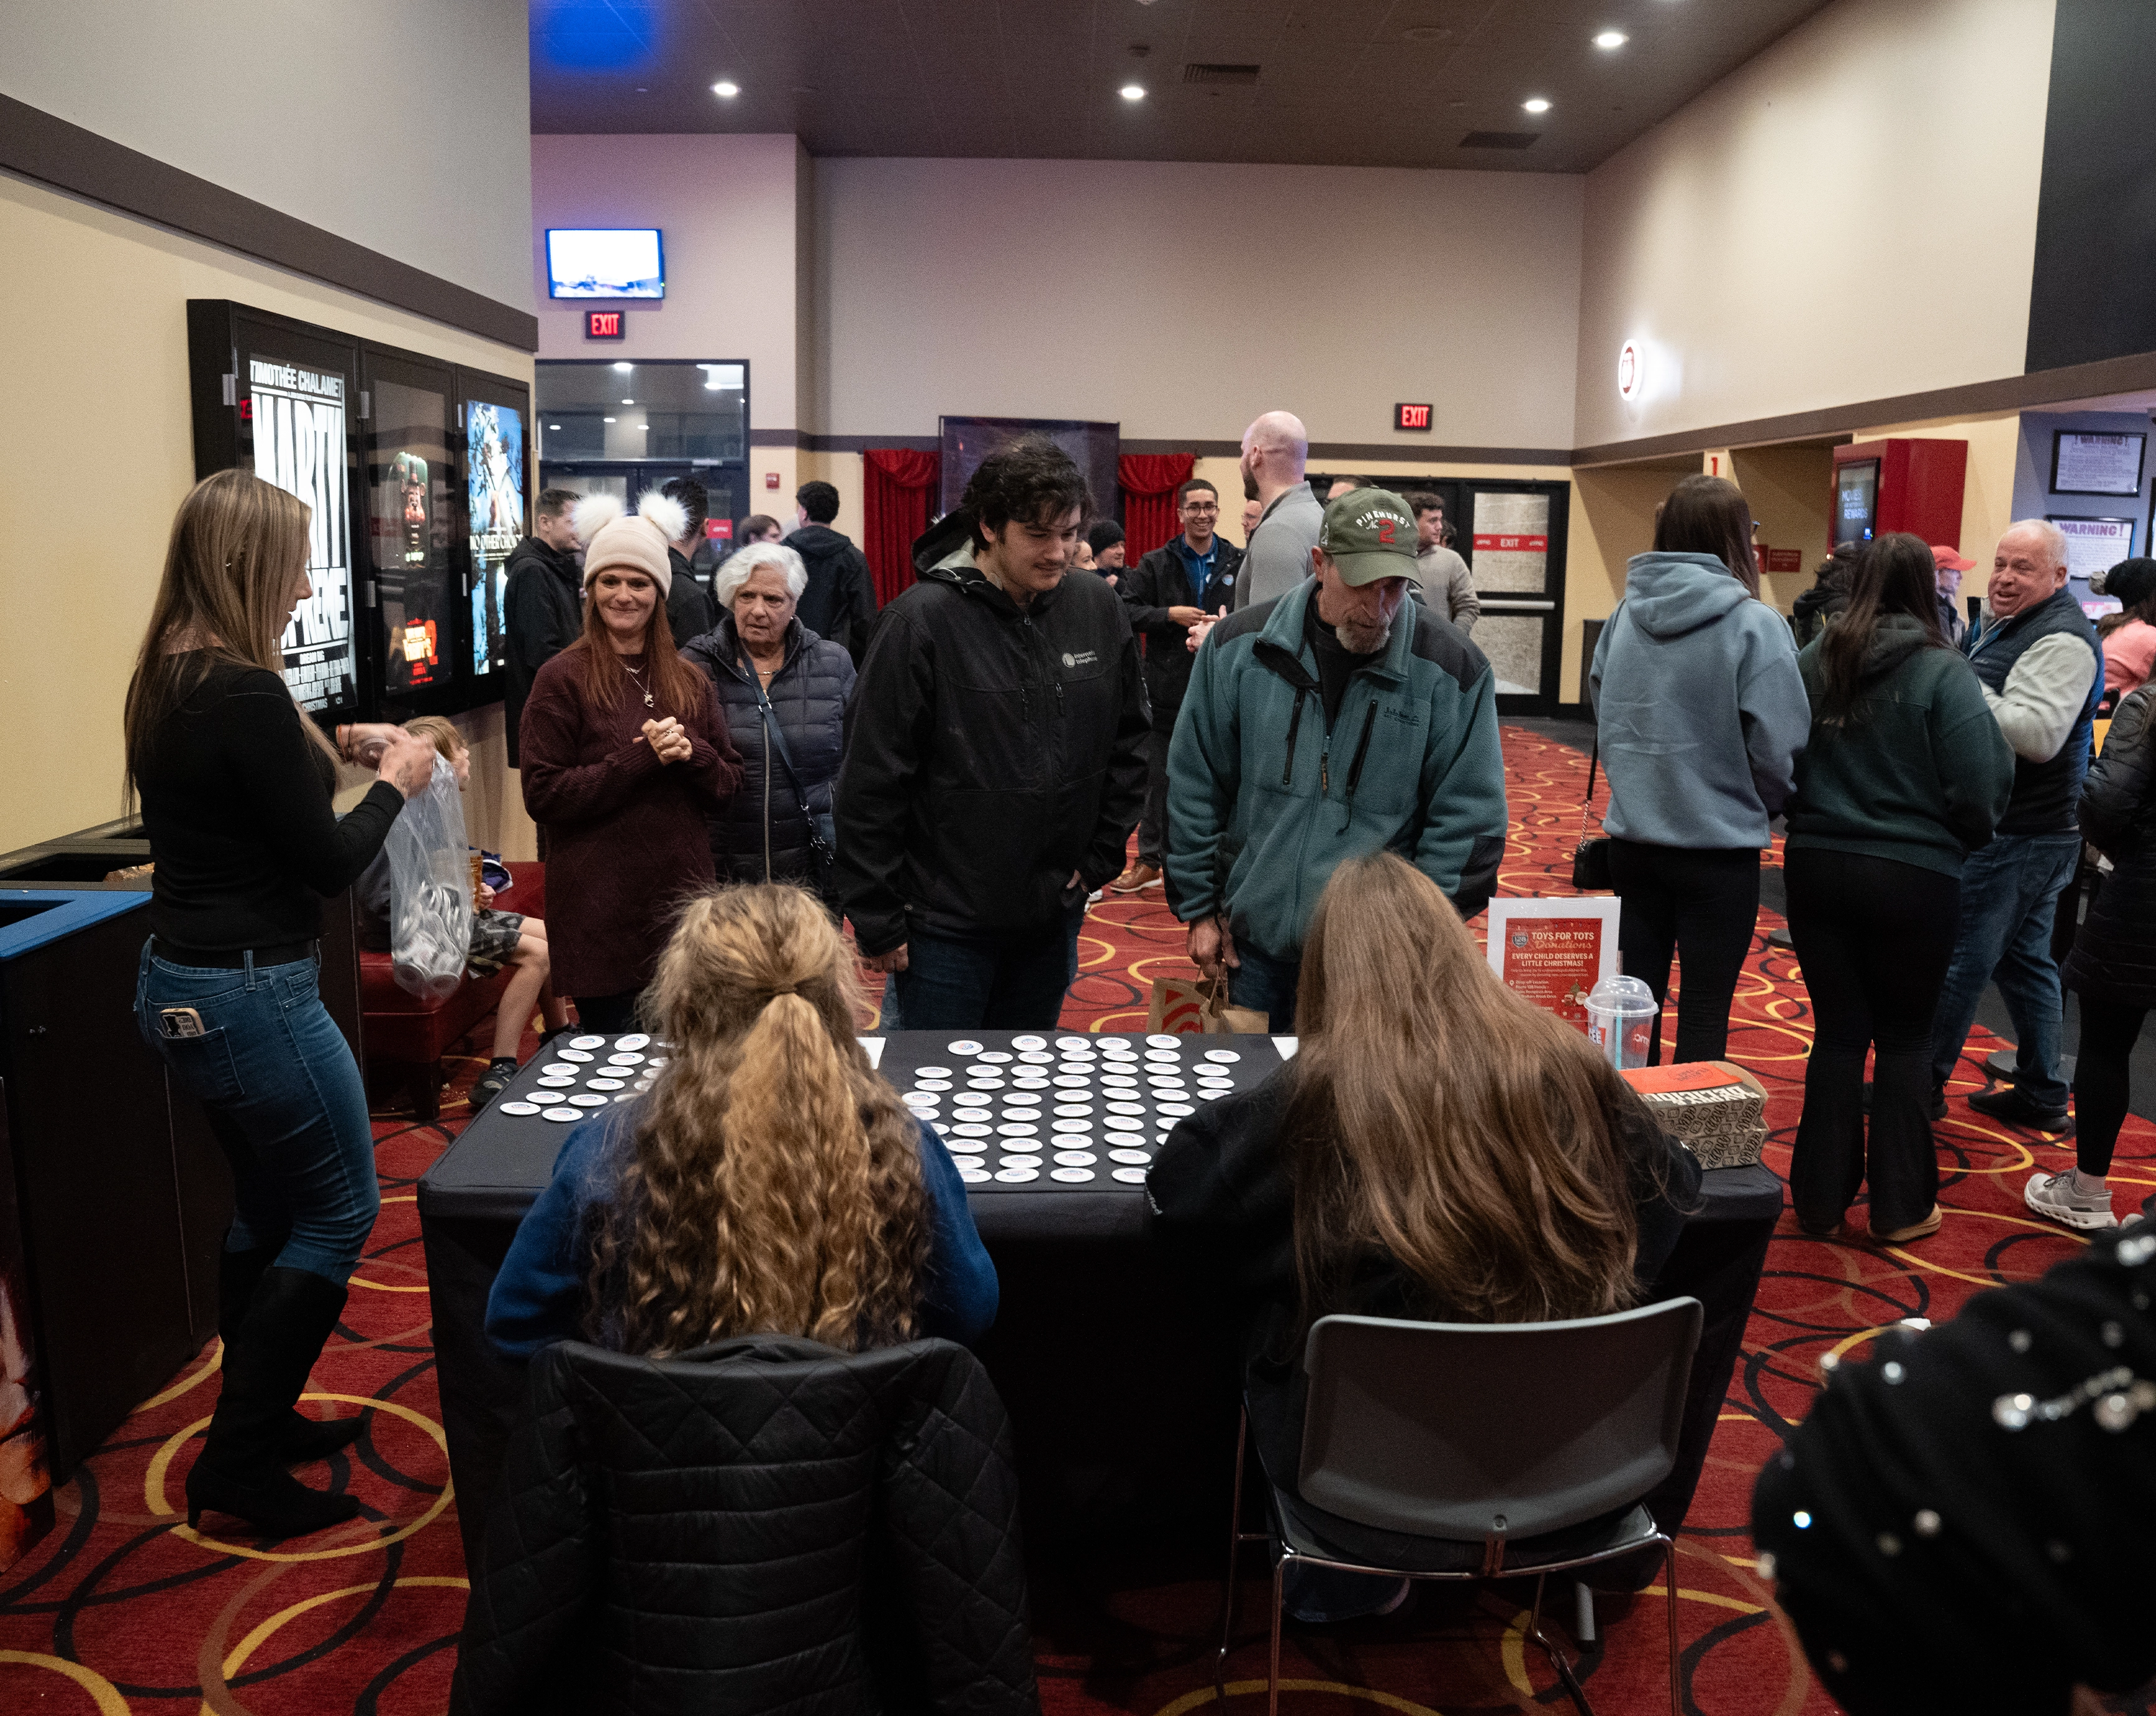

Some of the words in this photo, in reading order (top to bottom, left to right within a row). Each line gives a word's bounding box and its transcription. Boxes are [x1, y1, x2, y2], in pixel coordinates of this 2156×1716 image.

[591, 313, 620, 336] EXIT
[250, 359, 297, 390] TIMOTHÉE
[298, 370, 343, 398] CHALAMET
[1401, 405, 1429, 427] EXIT
[1356, 511, 1411, 529] PINEHURST
[1379, 519, 1396, 544] 2
[469, 535, 481, 550] NO
[1500, 538, 1519, 547] EXIT
[1532, 932, 1554, 940] TOYS
[1555, 932, 1571, 940] FOR
[1574, 932, 1594, 940] TOTS
[1534, 941, 1593, 949] Donations
